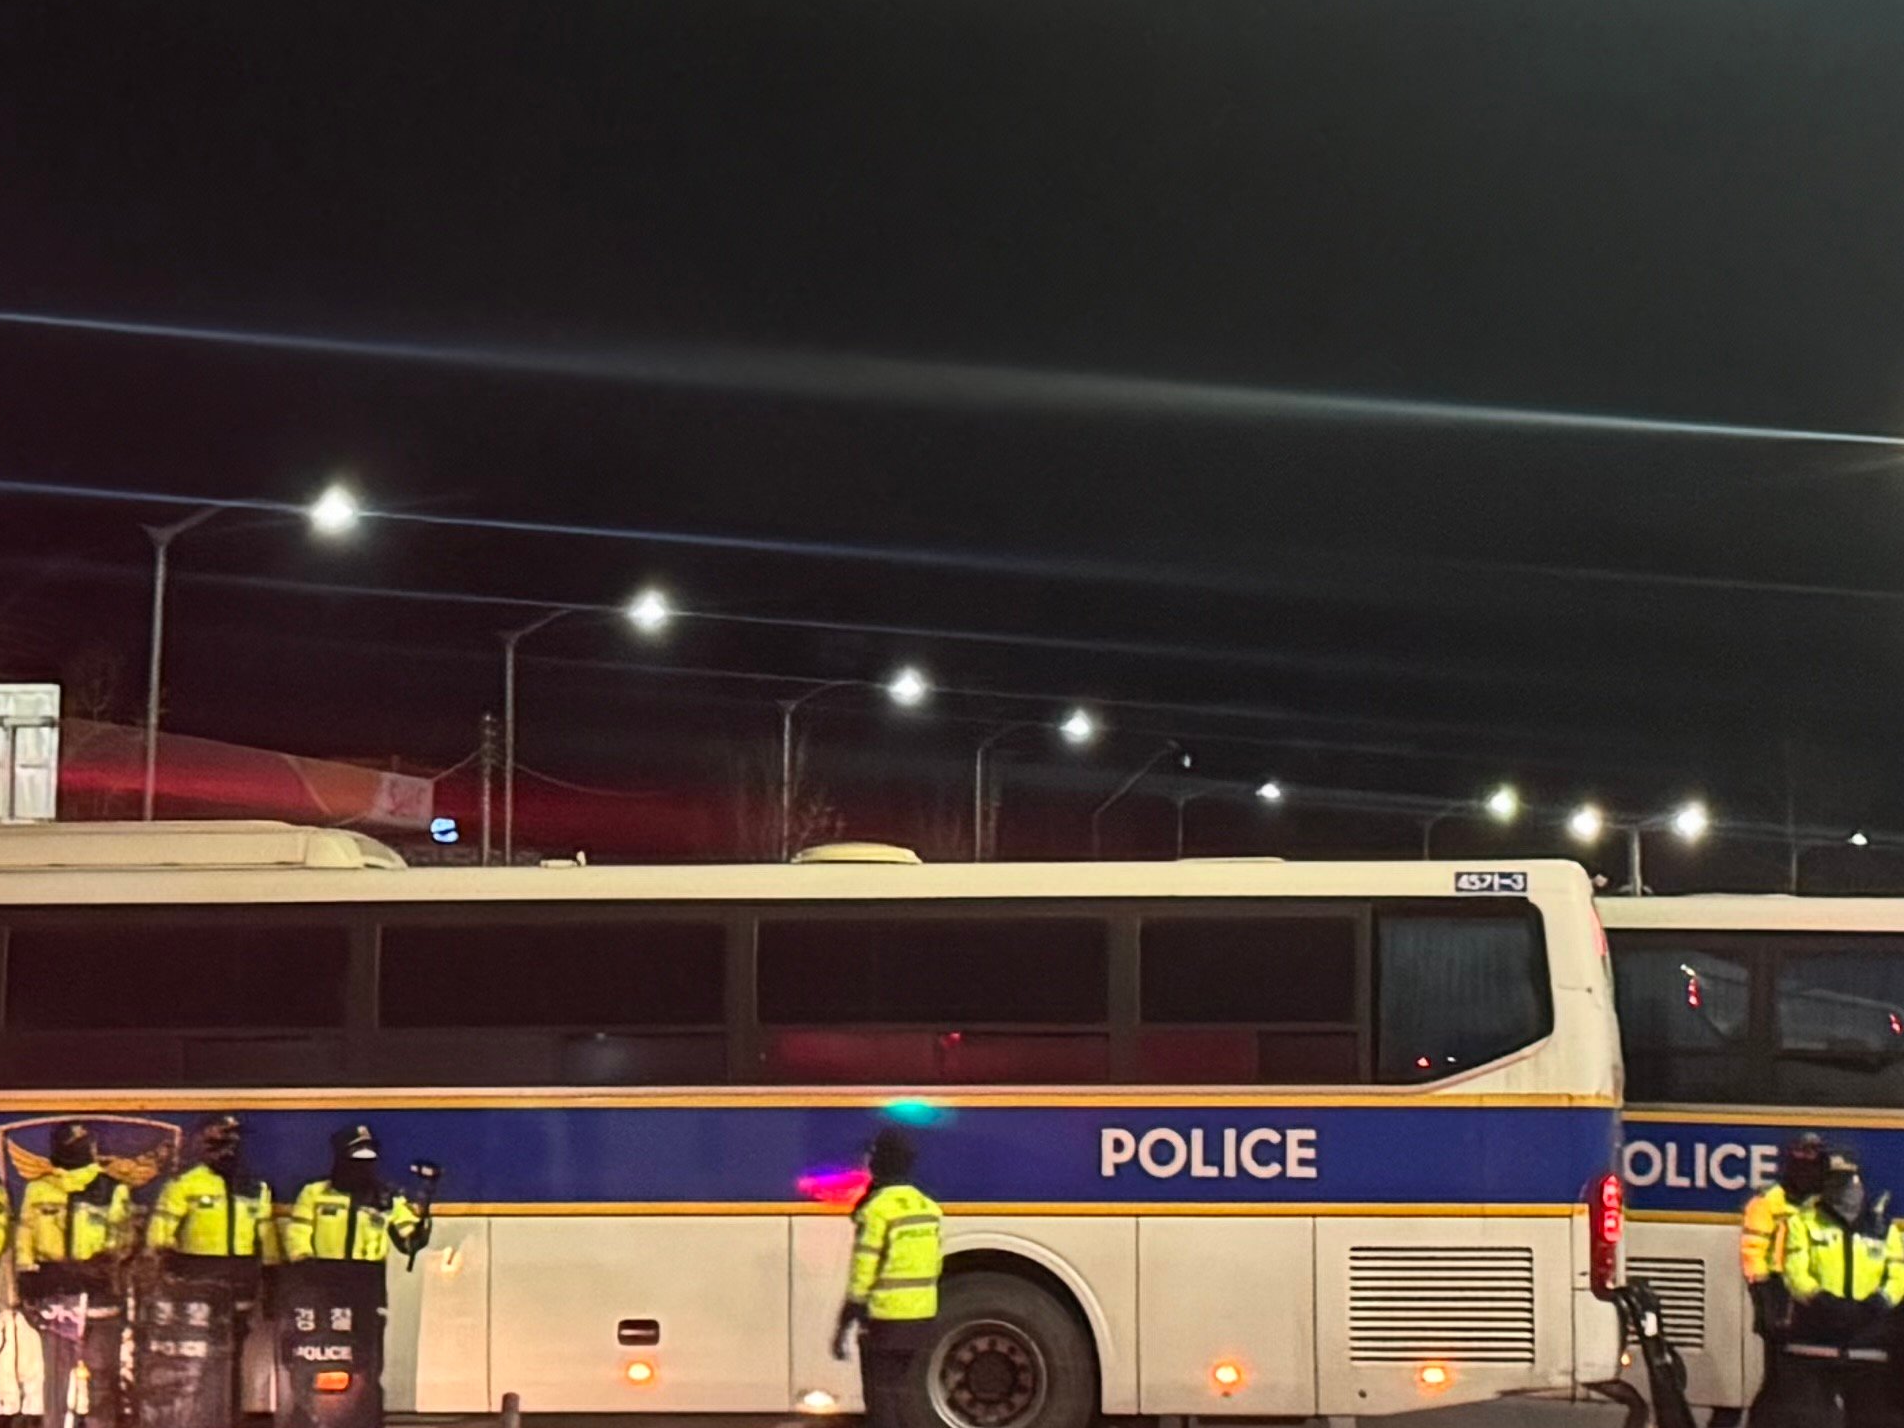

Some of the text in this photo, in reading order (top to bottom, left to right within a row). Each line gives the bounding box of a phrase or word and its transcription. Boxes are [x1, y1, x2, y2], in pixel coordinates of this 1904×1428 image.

[1457, 873, 1525, 891] 4571-3
[1101, 1127, 1318, 1178] POLICE
[1622, 1140, 1779, 1190] OLICE
